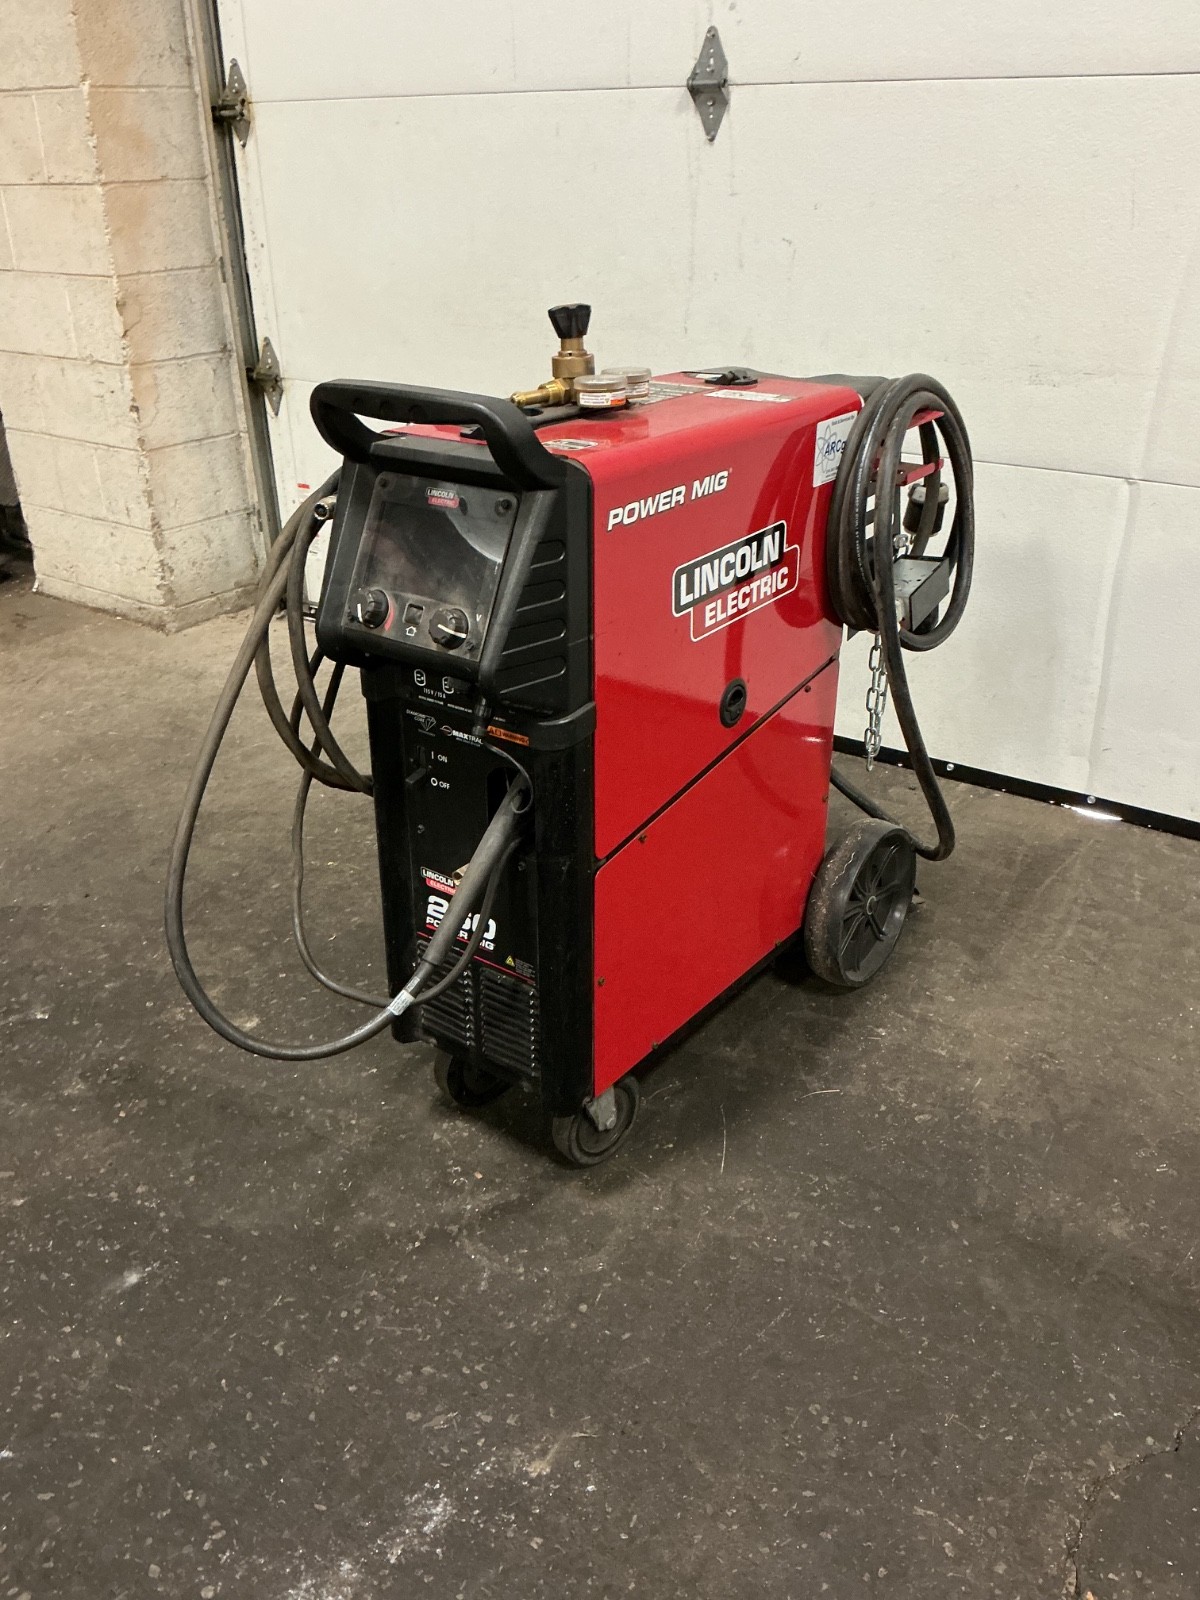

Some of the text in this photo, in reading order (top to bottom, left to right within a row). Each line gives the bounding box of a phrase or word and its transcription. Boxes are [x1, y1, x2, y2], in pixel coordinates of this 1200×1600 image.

[427, 488, 455, 499] LINCOLN
[431, 498, 456, 507] ELECTRIC
[607, 470, 729, 531] POWER MIG
[680, 531, 780, 606] LINCOLN
[704, 566, 789, 628] ELECTRIC
[437, 755, 448, 763] ON
[439, 781, 450, 789] OFF
[422, 868, 454, 887] LINCOLN
[425, 916, 468, 940] POR
